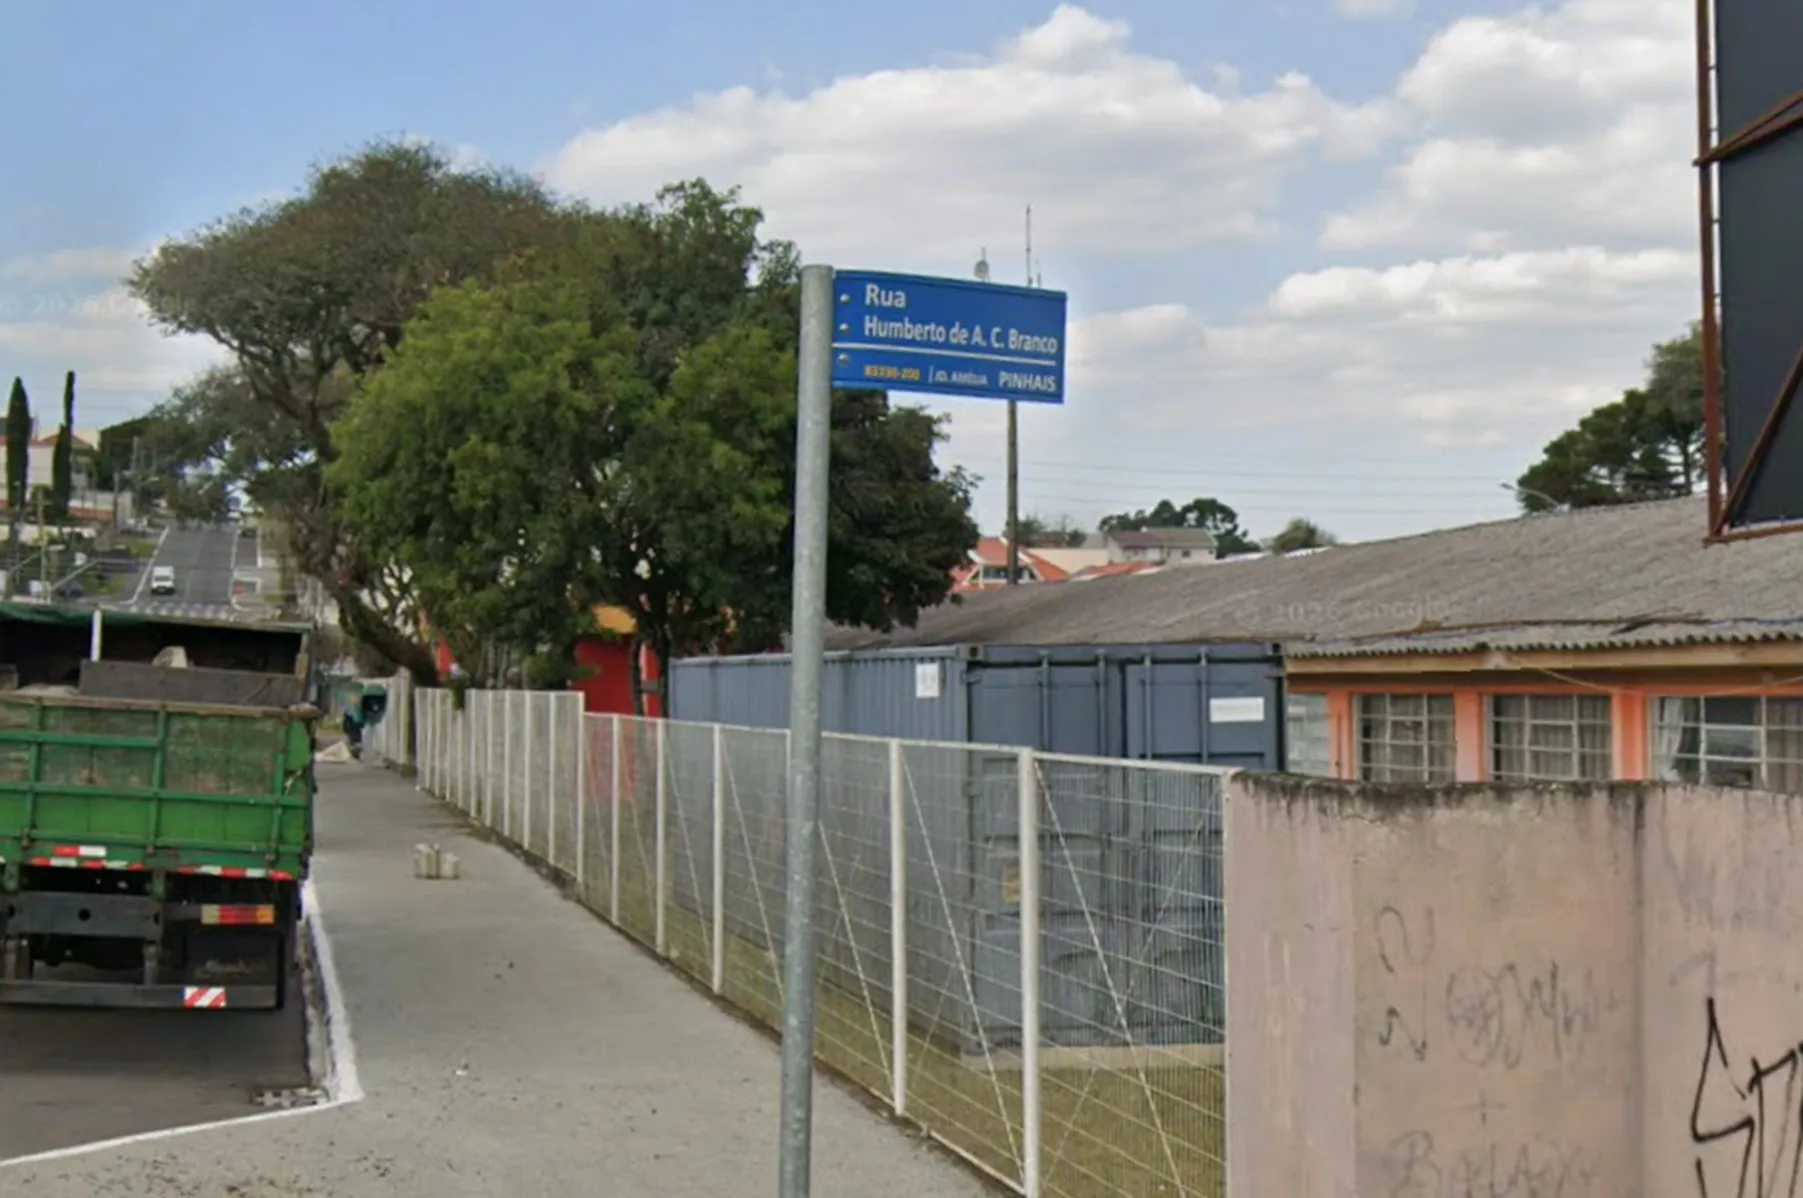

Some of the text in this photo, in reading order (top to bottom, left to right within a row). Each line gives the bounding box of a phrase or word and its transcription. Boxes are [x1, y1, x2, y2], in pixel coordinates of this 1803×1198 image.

[865, 283, 907, 309] Rua
[864, 315, 1059, 354] Humberto de A. C. Branco
[998, 371, 1058, 392] PINHAIS
